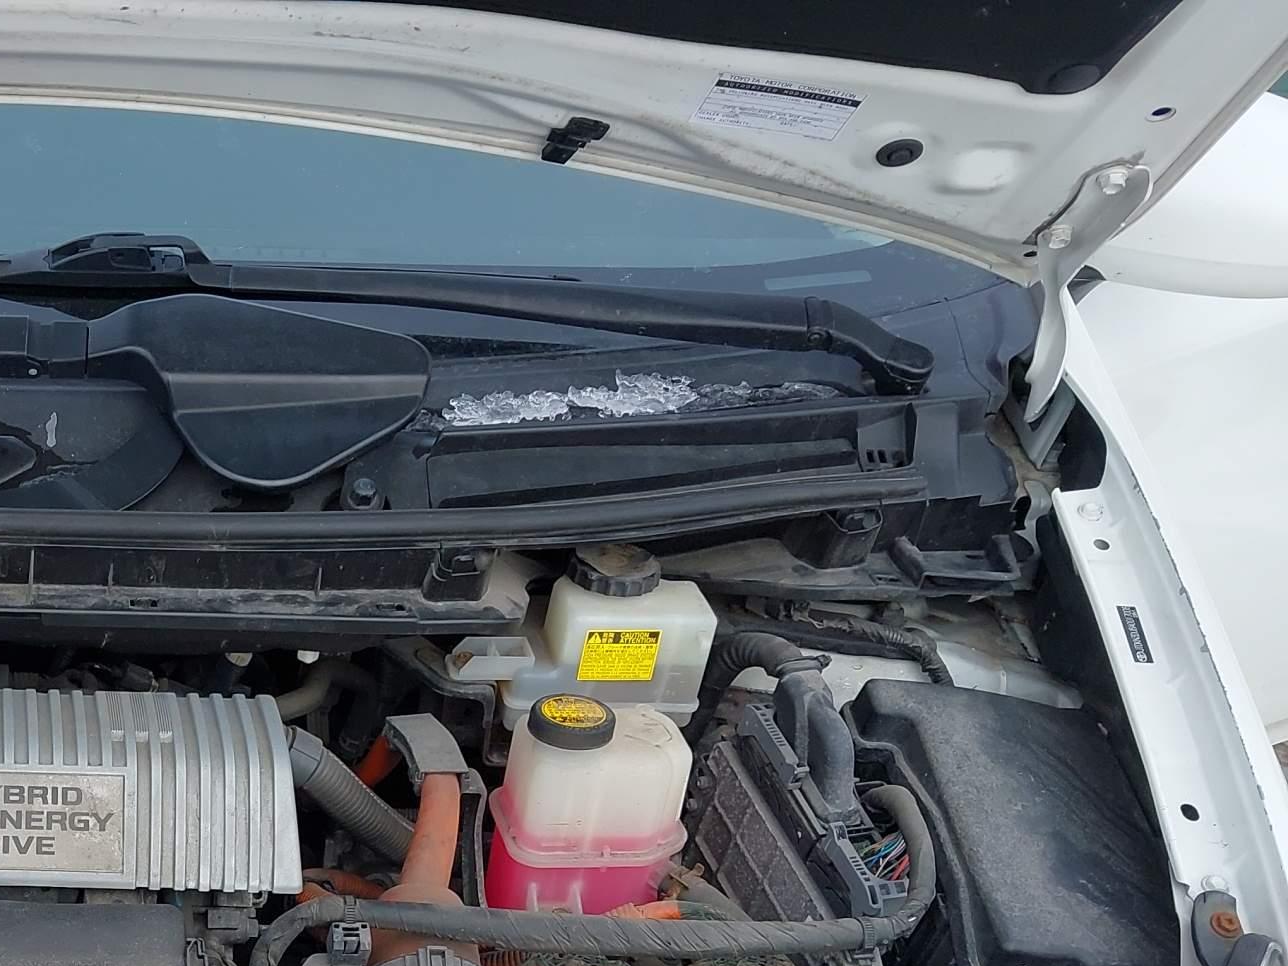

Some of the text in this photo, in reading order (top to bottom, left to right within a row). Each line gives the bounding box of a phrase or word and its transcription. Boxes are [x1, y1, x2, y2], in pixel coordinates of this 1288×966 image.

[730, 75, 857, 99] TOYOTA MOTOR CORPORATION
